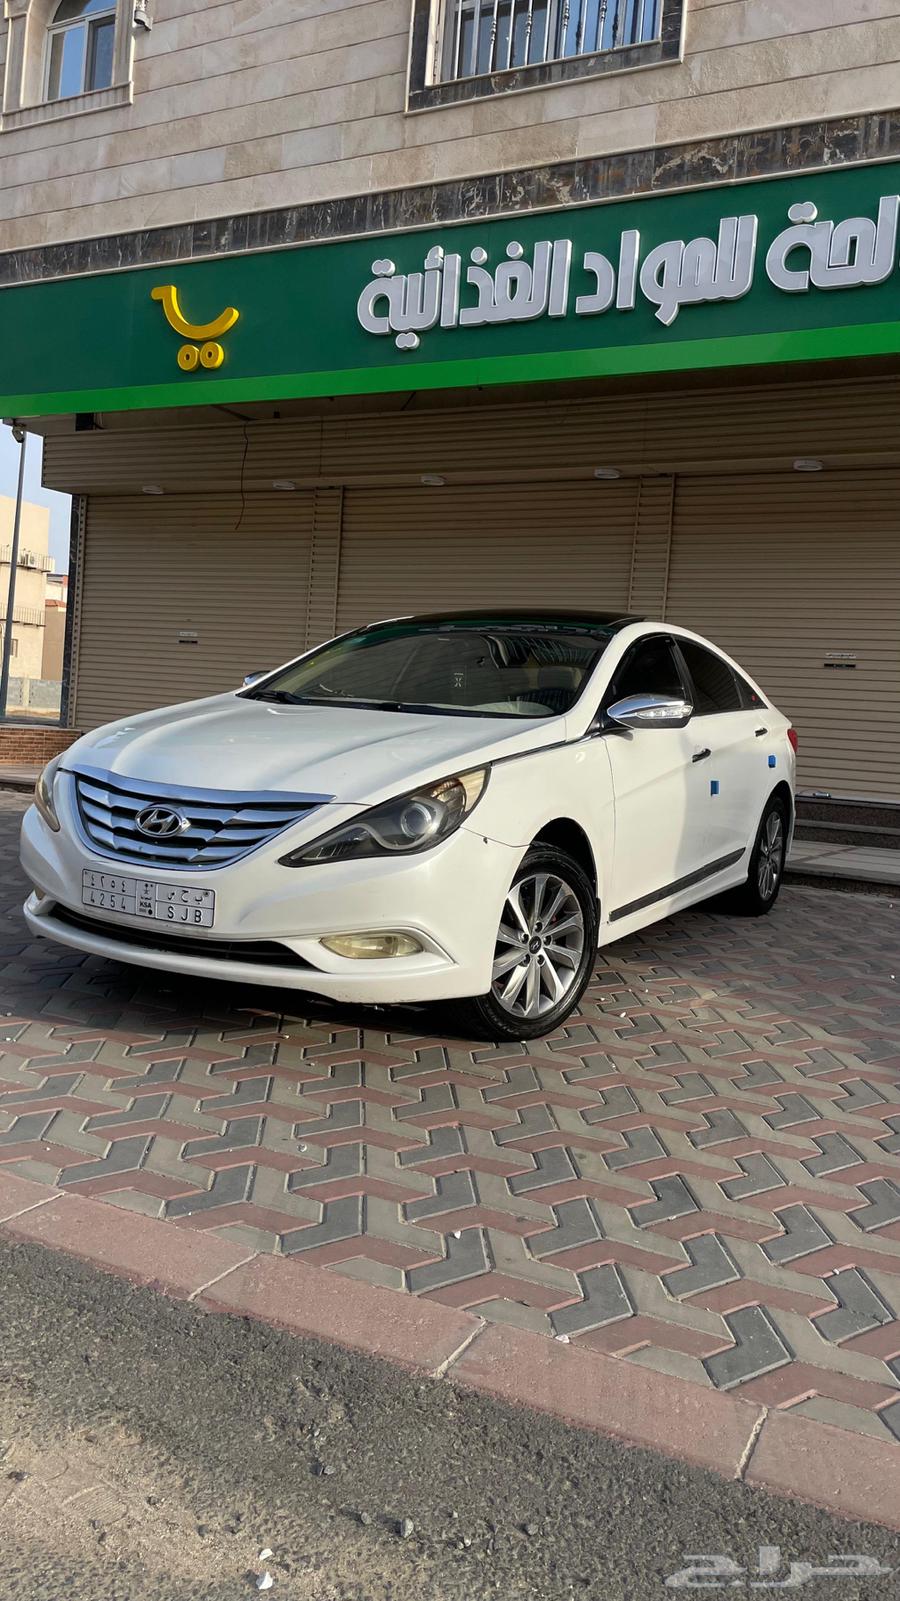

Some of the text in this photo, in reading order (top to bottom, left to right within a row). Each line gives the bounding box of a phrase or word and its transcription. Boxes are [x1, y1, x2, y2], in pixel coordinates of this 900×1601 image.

[356, 239, 572, 350] الغذائية
[575, 214, 758, 326] للمواد
[90, 890, 126, 910] 4254
[167, 905, 202, 923] SJB
